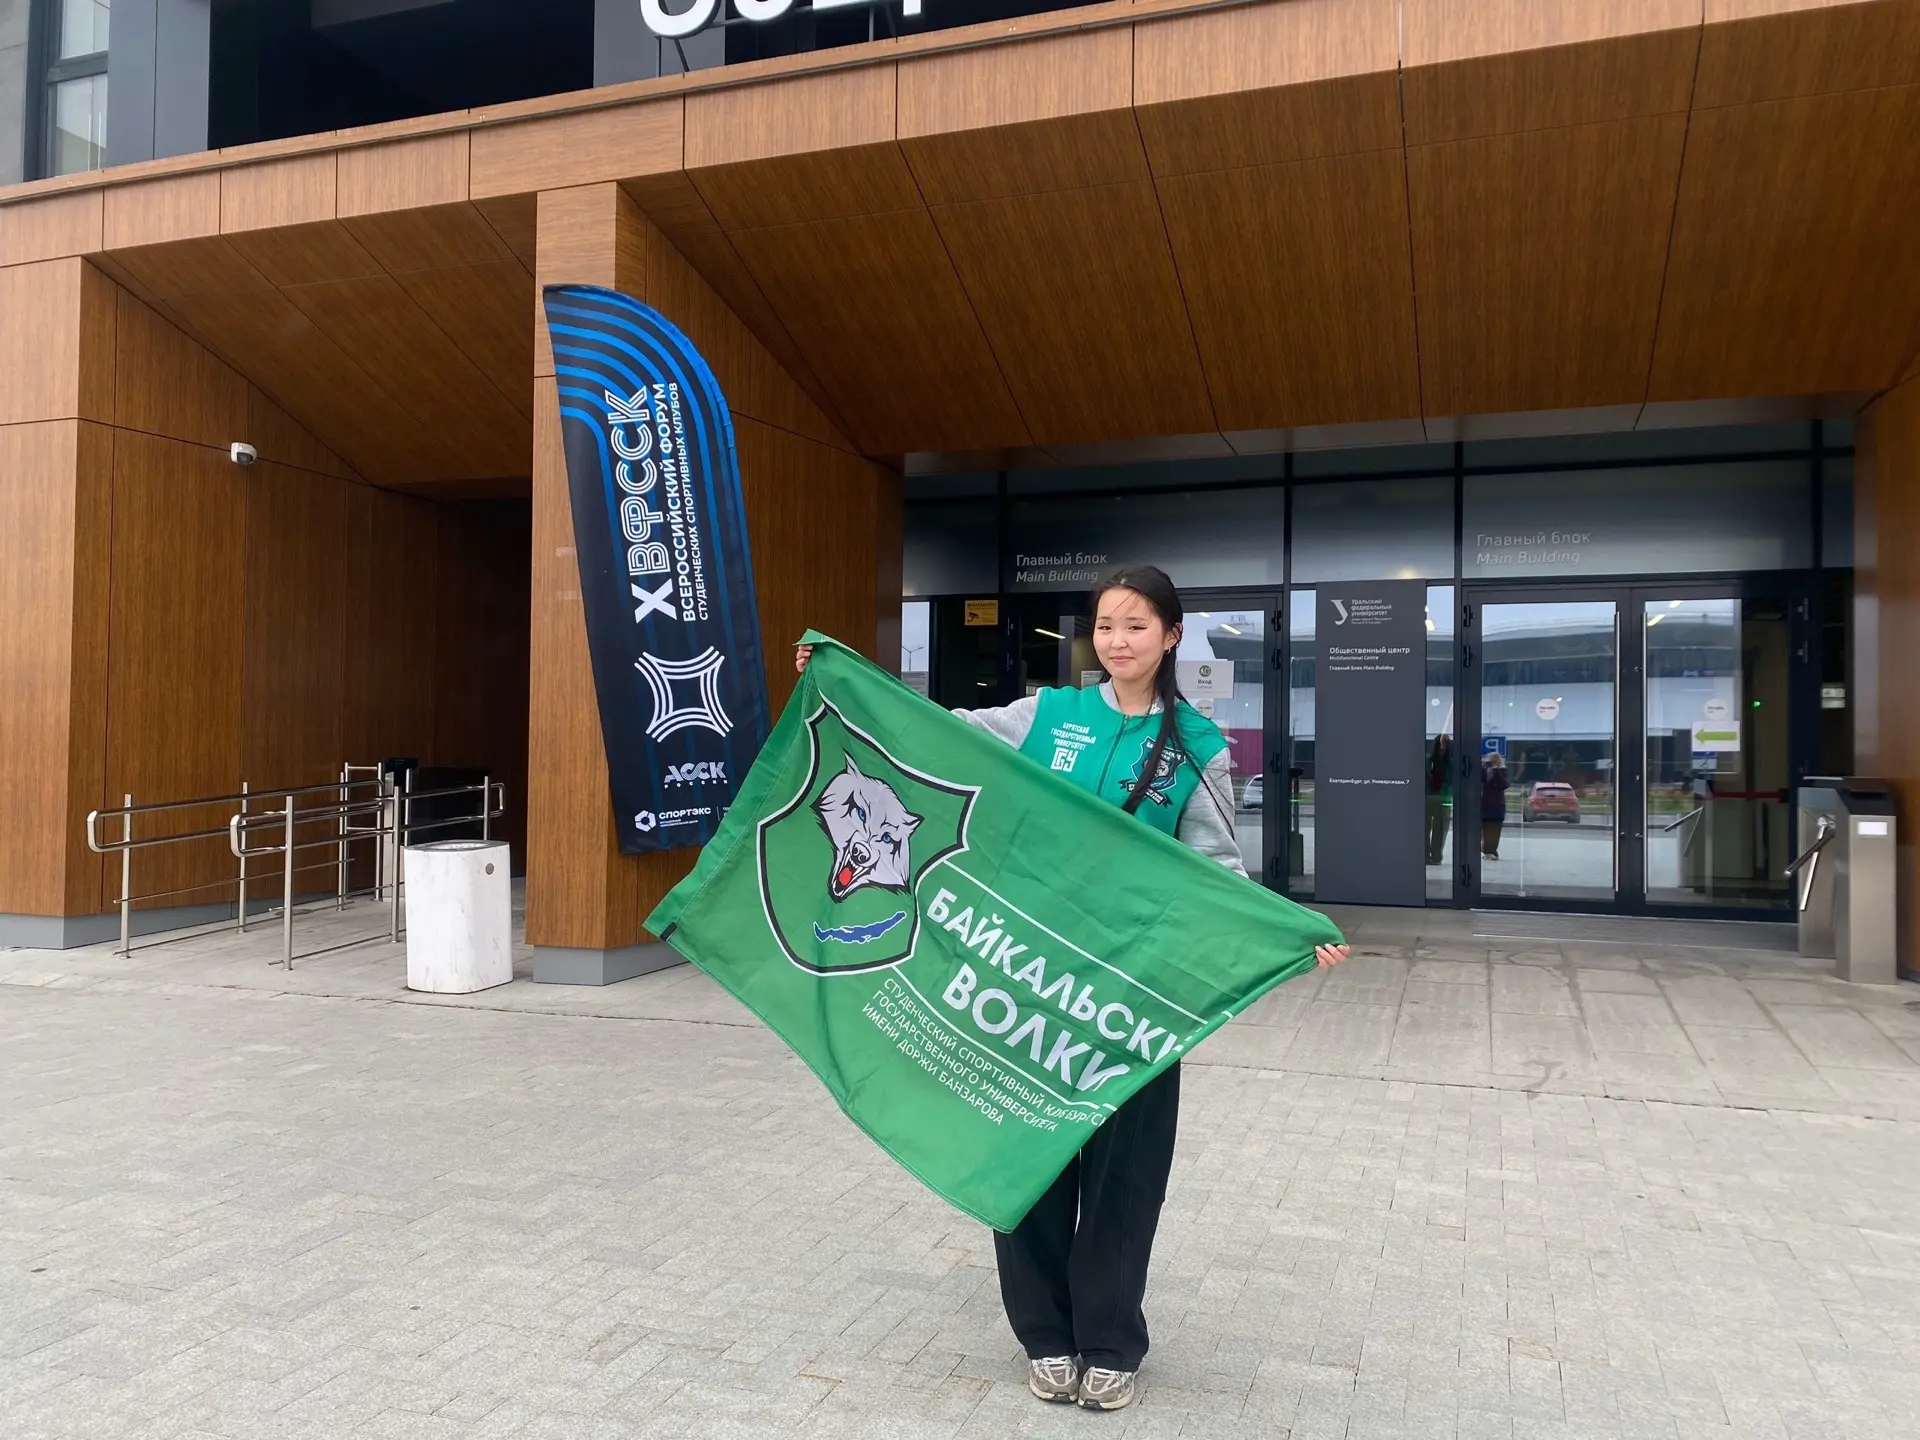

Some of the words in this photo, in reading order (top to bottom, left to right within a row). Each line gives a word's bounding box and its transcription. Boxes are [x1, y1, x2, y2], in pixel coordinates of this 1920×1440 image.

[652, 383, 674, 454] ФОРУМ
[668, 382, 683, 434] КЛУБОВ
[605, 385, 671, 576] ВФССК
[676, 436, 696, 524] СПОРТИВНЫХ
[659, 458, 696, 622] ВСЕРОССИЙСКИЙ
[687, 525, 708, 621] СТУДЕНЧЕСКИХ
[1016, 552, 1072, 567] Главный
[1075, 552, 1108, 565] блок
[1016, 571, 1045, 583] Main
[1048, 569, 1099, 584] Building
[1476, 552, 1513, 565] Main
[1517, 550, 1580, 566] Building
[1477, 531, 1547, 547] Главный
[1551, 530, 1592, 545] блок
[1329, 646, 1387, 655] Общественный
[1387, 647, 1411, 655] центр
[658, 807, 712, 820] СПОРТЭКС
[926, 887, 1184, 1065] БАЙКАЛЬСКИ
[861, 1002, 900, 1042] ИМЕНИ
[896, 1038, 939, 1076] ДОРЖИ
[938, 1071, 1004, 1126] БАНЗАРОВА
[872, 989, 979, 1084] ГОСУДАРСТВЕННОГО
[884, 978, 958, 1052] СТУДЕНЧЕСКИЙ
[958, 1047, 1046, 1109] СПОРТИВНЫЙ
[941, 962, 1131, 1092] ВОЛКИ
